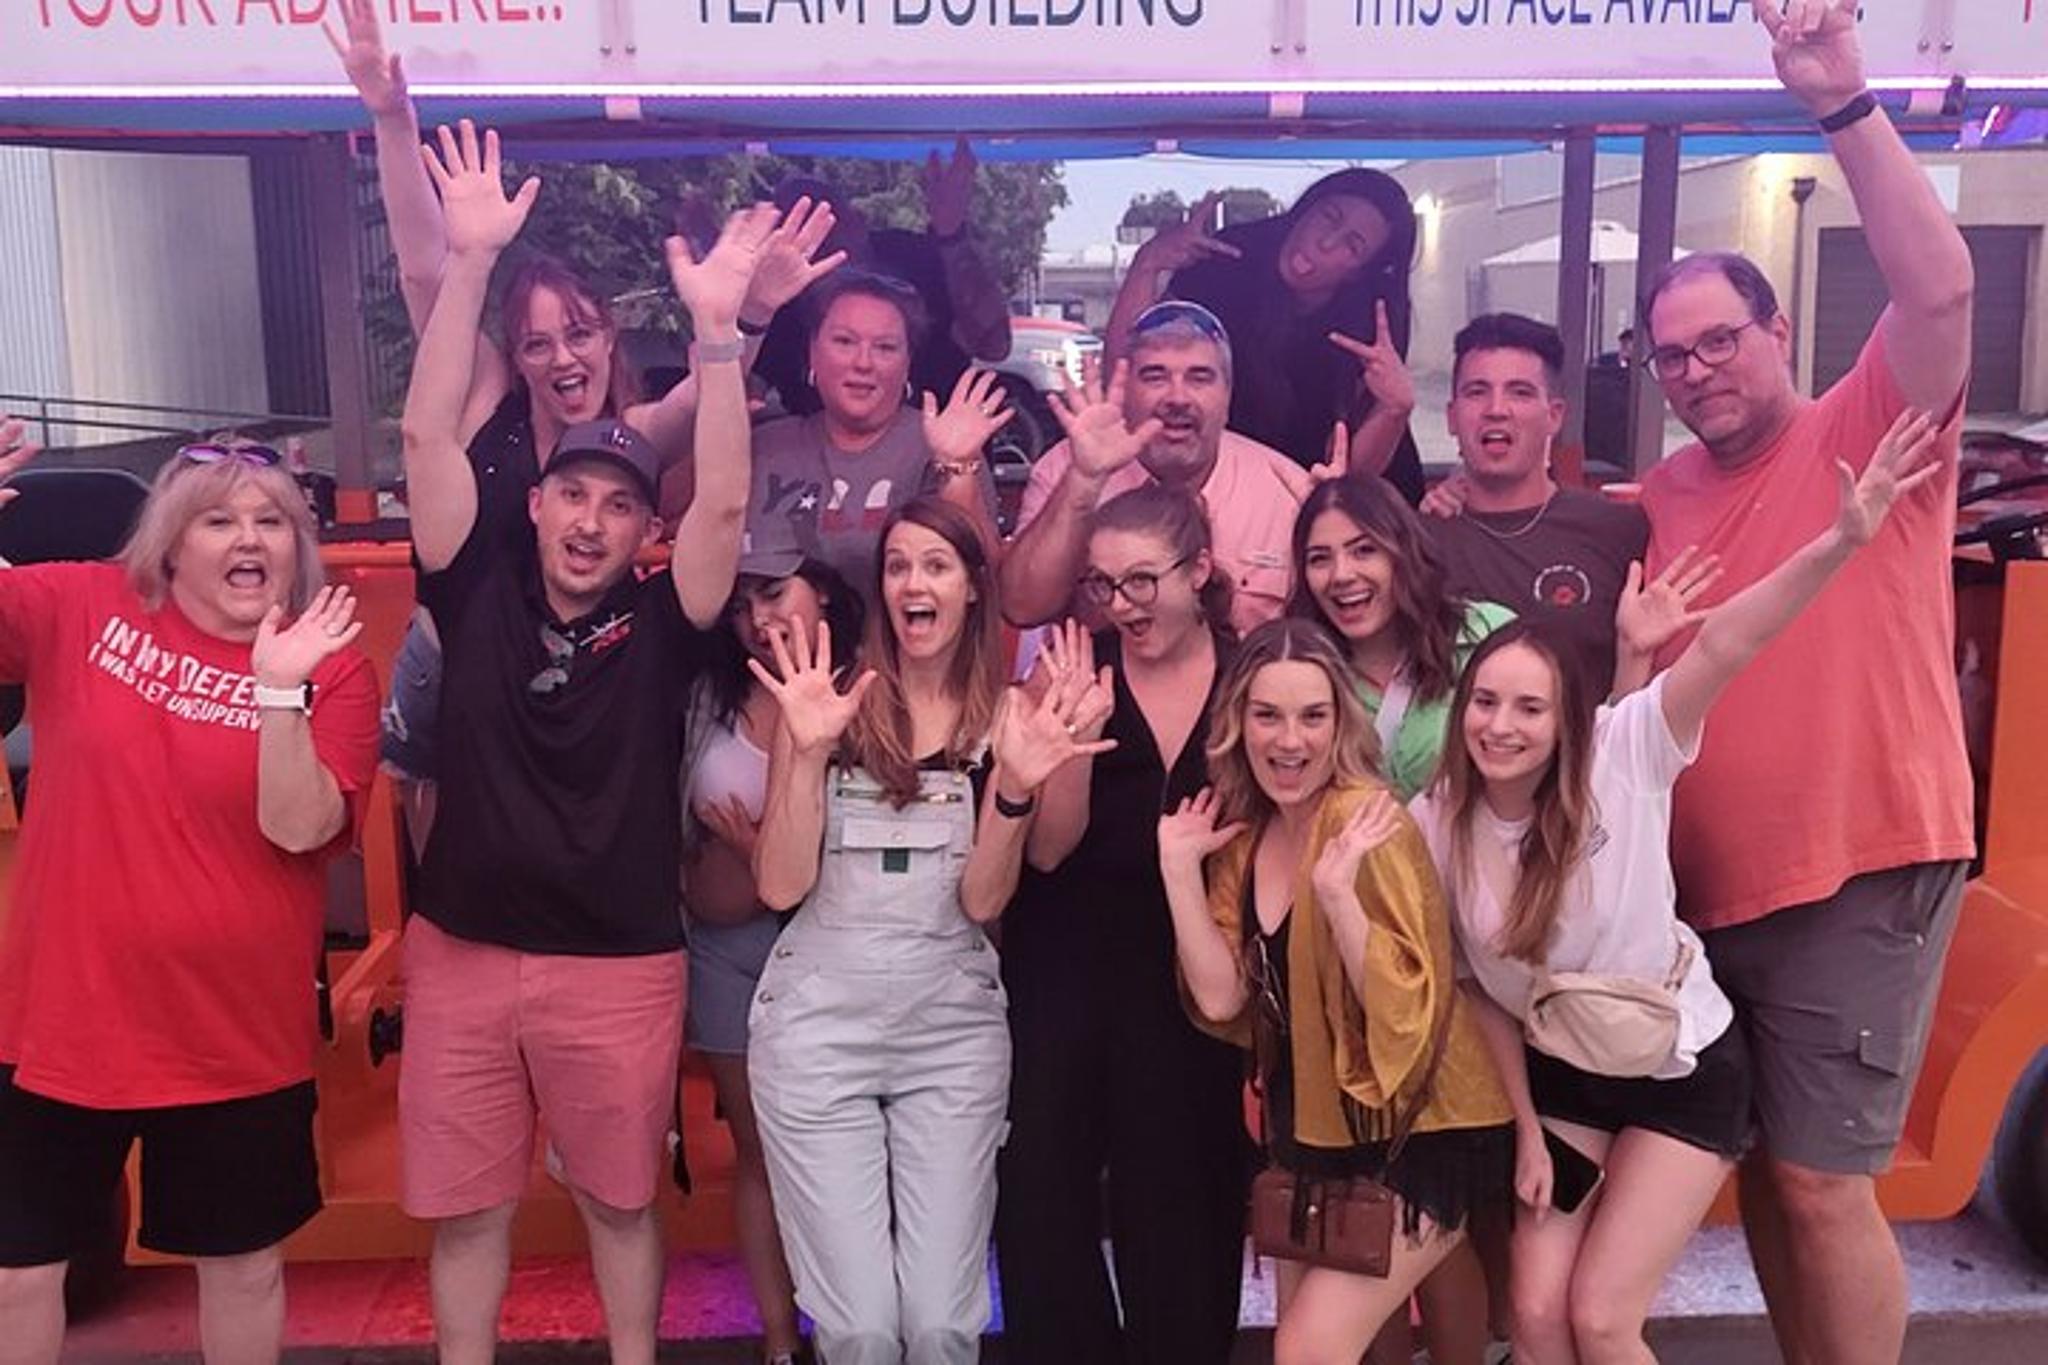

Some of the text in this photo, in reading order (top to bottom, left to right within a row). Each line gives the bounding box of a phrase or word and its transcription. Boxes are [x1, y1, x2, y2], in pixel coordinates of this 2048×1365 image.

[87, 642, 101, 663] I
[99, 651, 136, 685] WAS
[136, 678, 171, 703] LET
[102, 616, 258, 706] IN MY DEFE
